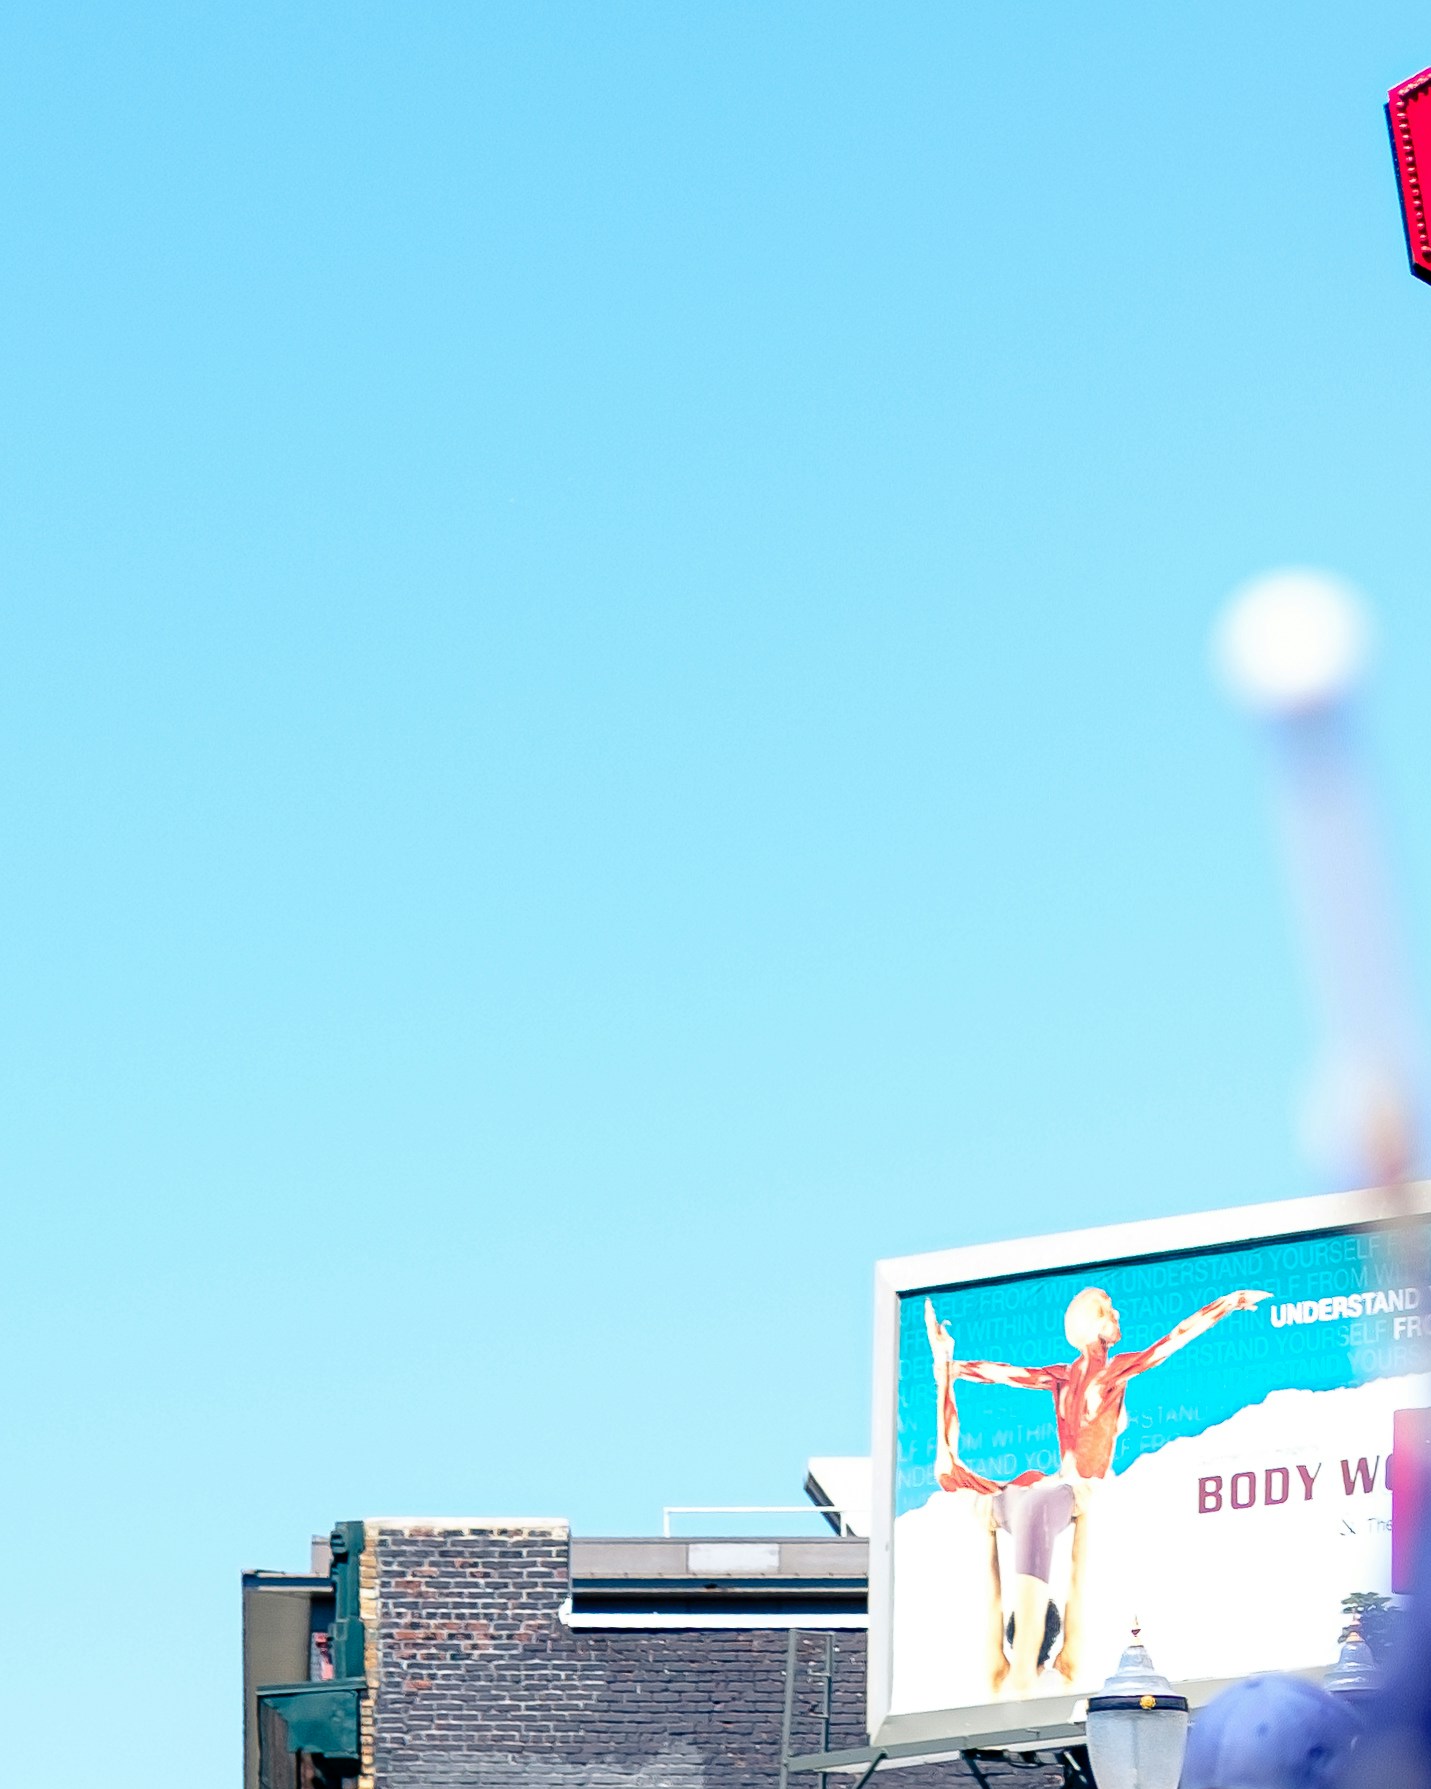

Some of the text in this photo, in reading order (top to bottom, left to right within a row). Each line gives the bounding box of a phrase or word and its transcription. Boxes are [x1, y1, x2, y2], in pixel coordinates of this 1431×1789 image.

[1122, 1251, 1262, 1294] UNDERSTAND
[1268, 1235, 1376, 1272] YOURSELF
[1271, 1283, 1420, 1330] UNDERSTAND
[1198, 1462, 1321, 1513] BODY
